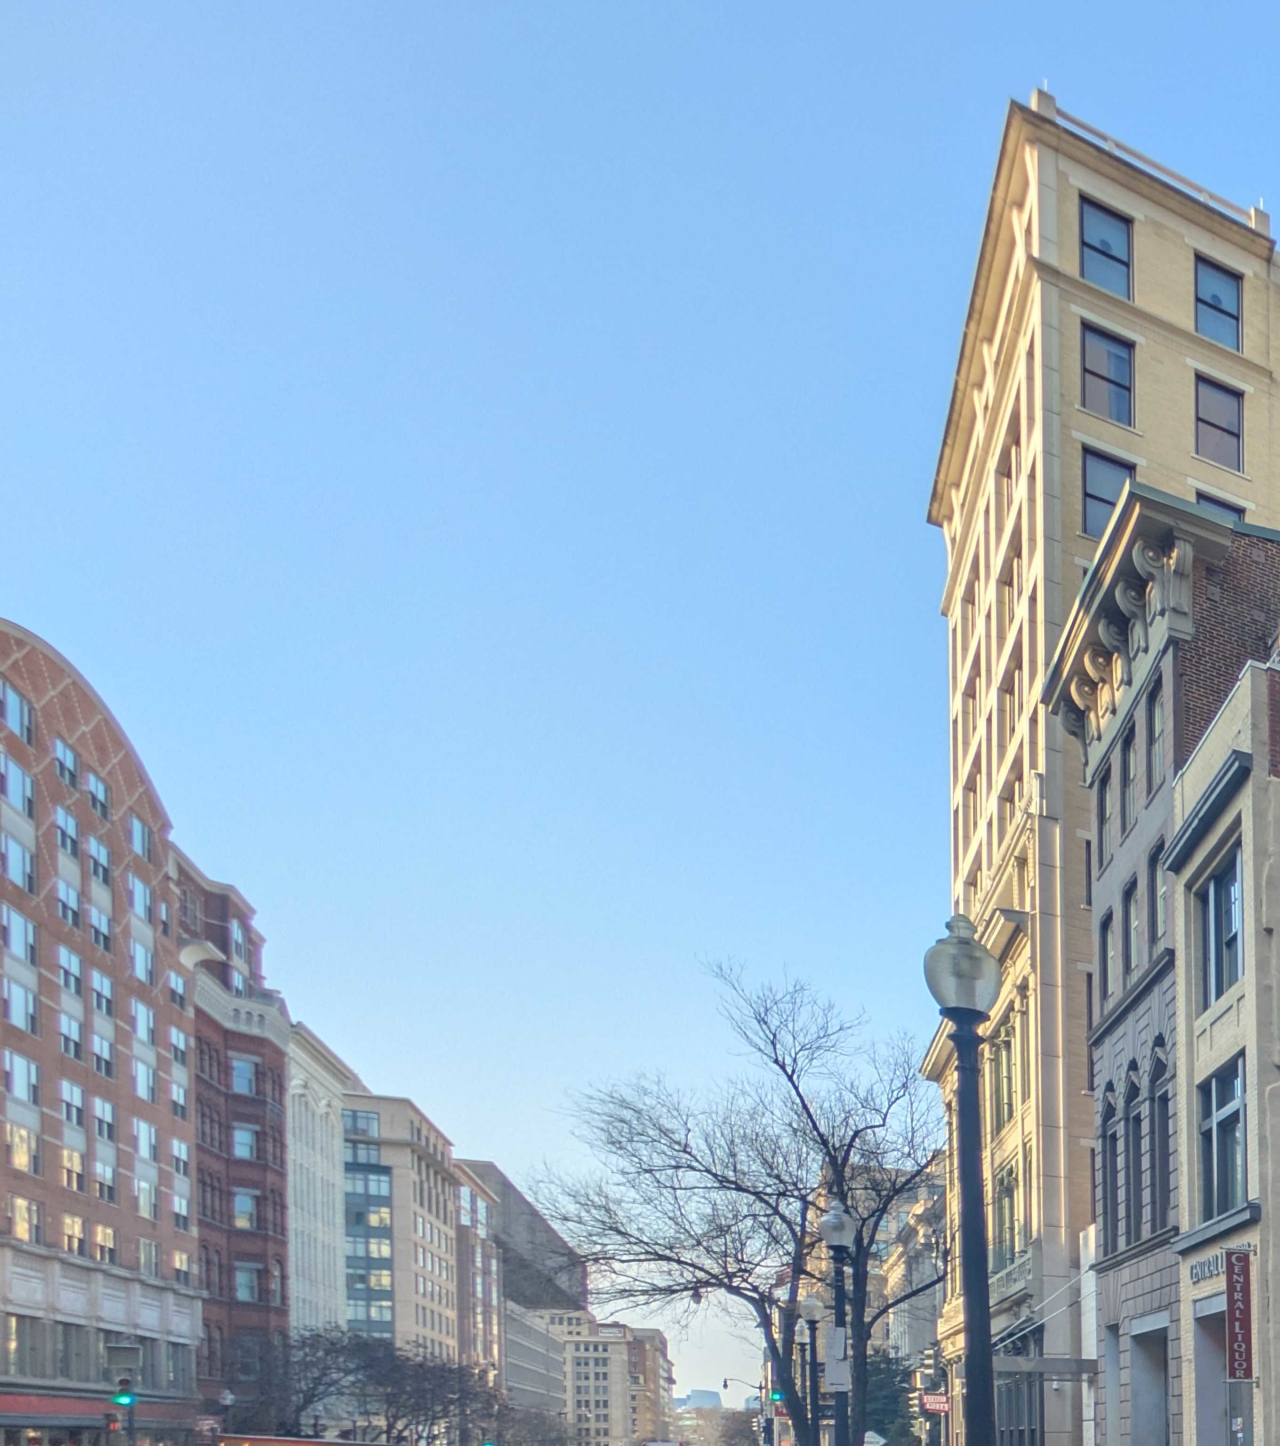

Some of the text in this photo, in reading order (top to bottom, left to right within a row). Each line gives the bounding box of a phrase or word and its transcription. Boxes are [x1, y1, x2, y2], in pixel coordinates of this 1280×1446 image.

[1190, 1253, 1220, 1285] CENTRAL
[1230, 1253, 1245, 1319] CENTRAL
[1233, 1321, 1247, 1379] LIQUOR
